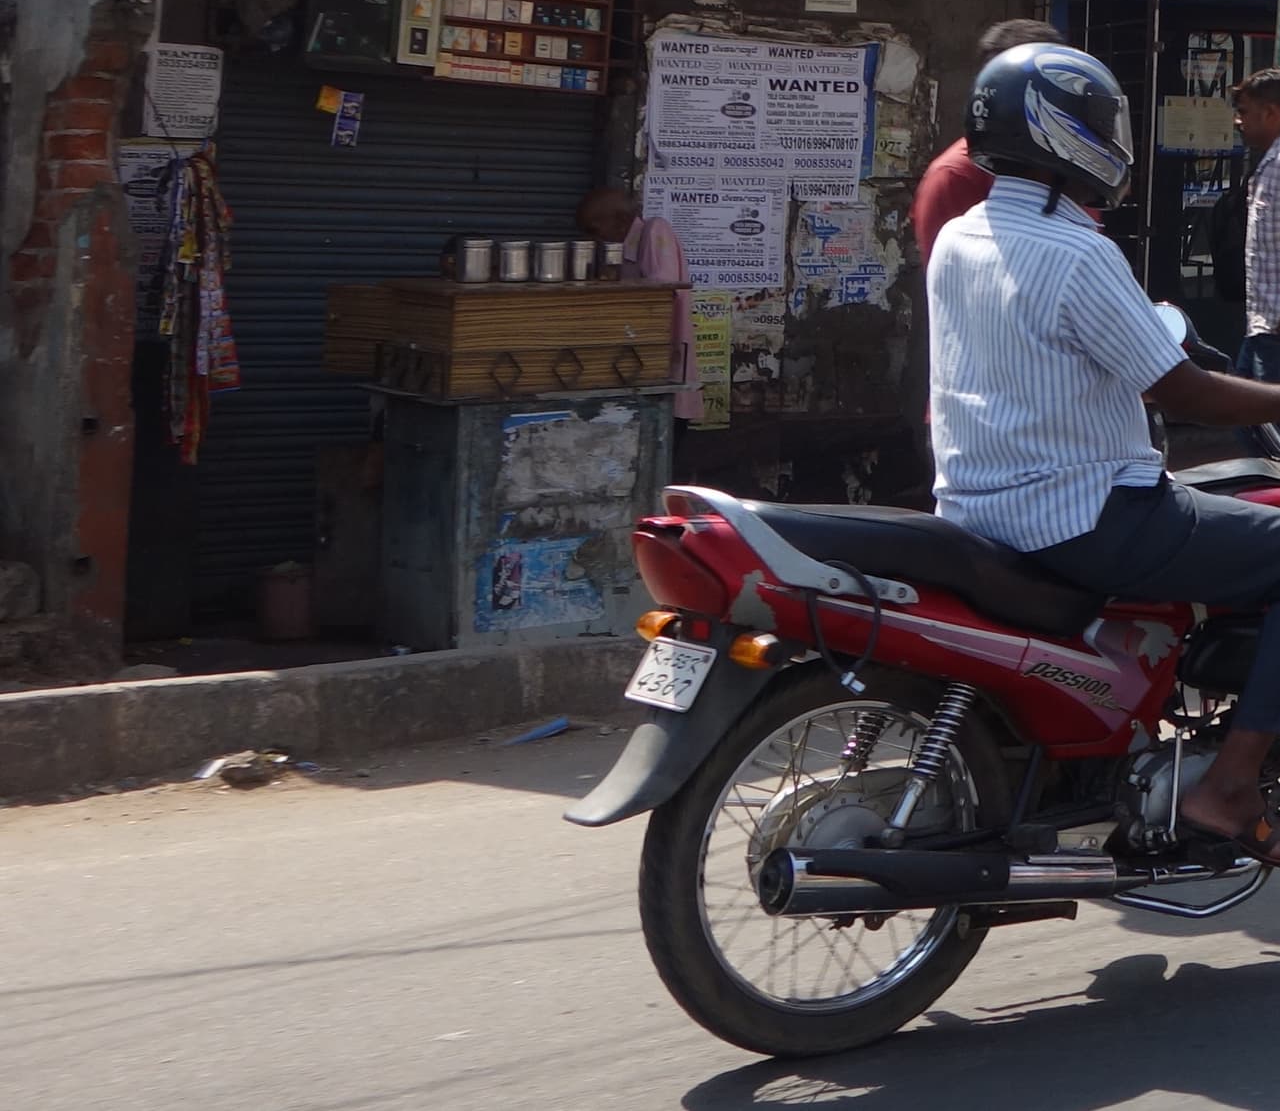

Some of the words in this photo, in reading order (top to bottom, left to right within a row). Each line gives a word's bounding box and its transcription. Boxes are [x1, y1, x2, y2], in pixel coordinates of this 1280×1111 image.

[661, 41, 710, 56] WANTED
[768, 46, 815, 60] WANTED
[157, 48, 220, 62] WANTED
[655, 58, 701, 70] WANTED
[728, 61, 773, 73] WANTED
[798, 63, 841, 75] WANTED
[661, 73, 710, 87] WANTED
[768, 78, 860, 94] WANTED
[671, 156, 715, 167] 8535042
[723, 156, 785, 168] 9008535042
[794, 158, 854, 169] 9008535042
[649, 176, 695, 187] WANTED
[721, 177, 766, 188] WANTED
[670, 193, 720, 204] WANTED
[718, 272, 780, 283] 9008535042
[1023, 661, 1112, 697] passion
